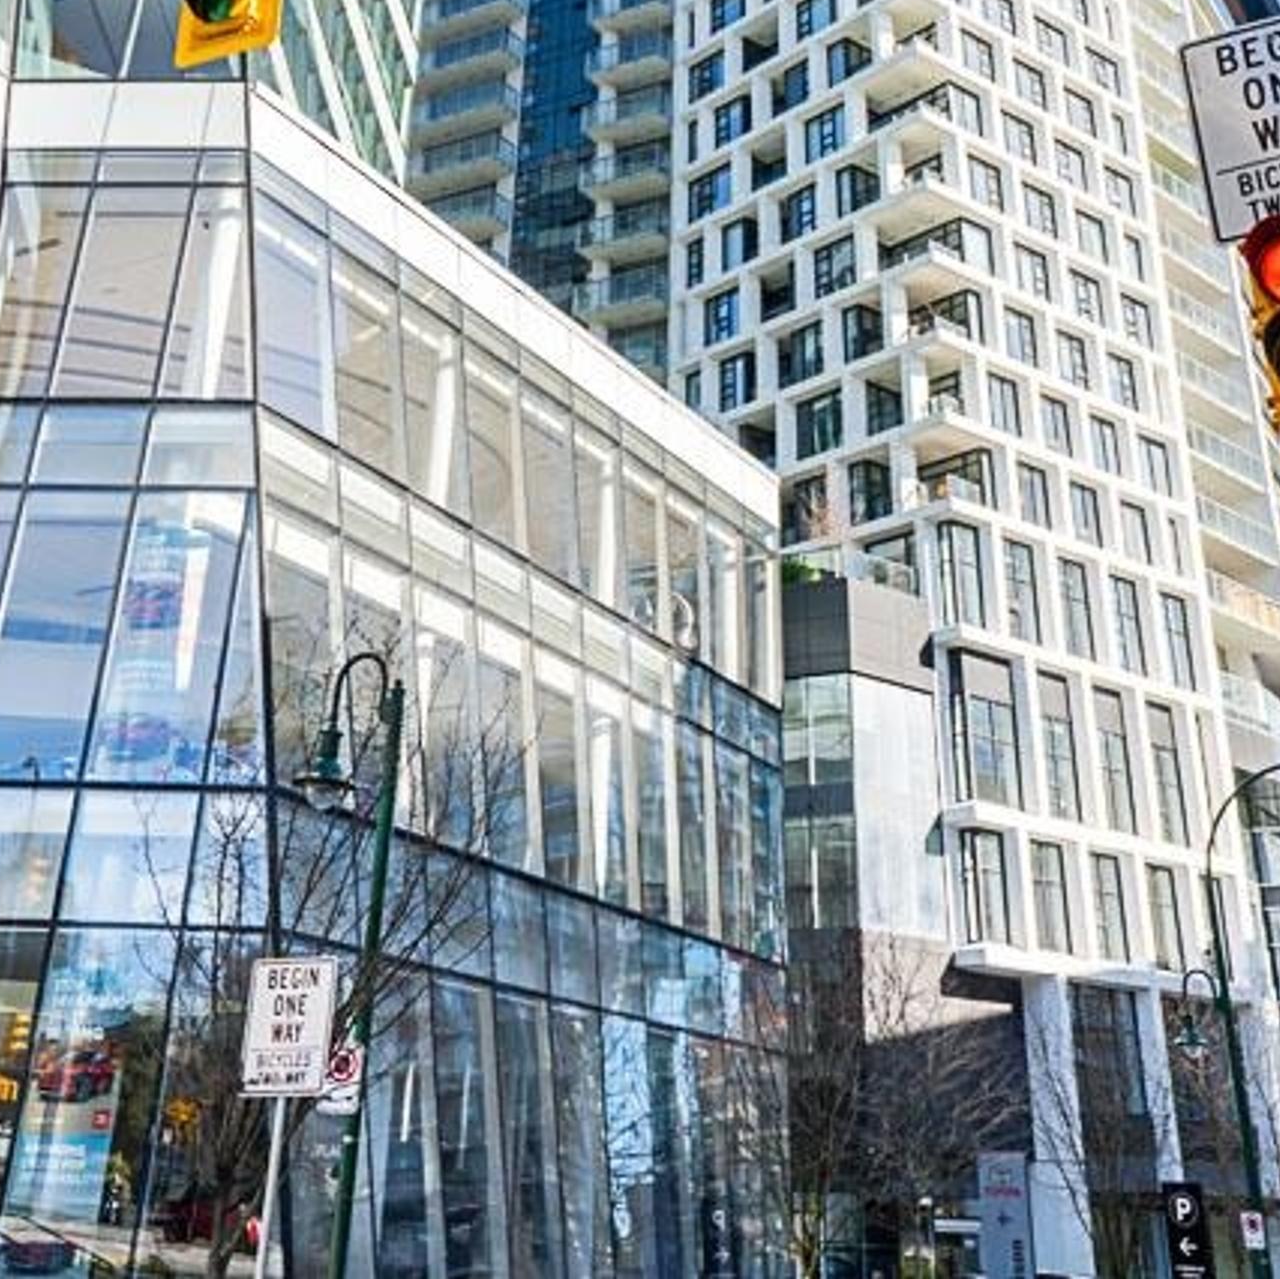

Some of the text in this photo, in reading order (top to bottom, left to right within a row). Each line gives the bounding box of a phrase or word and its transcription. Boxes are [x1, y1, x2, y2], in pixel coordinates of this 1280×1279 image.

[268, 967, 319, 989] BEGIN
[274, 994, 307, 1016] ONE
[272, 1022, 303, 1042] WAY
[1176, 1198, 1191, 1220] P
